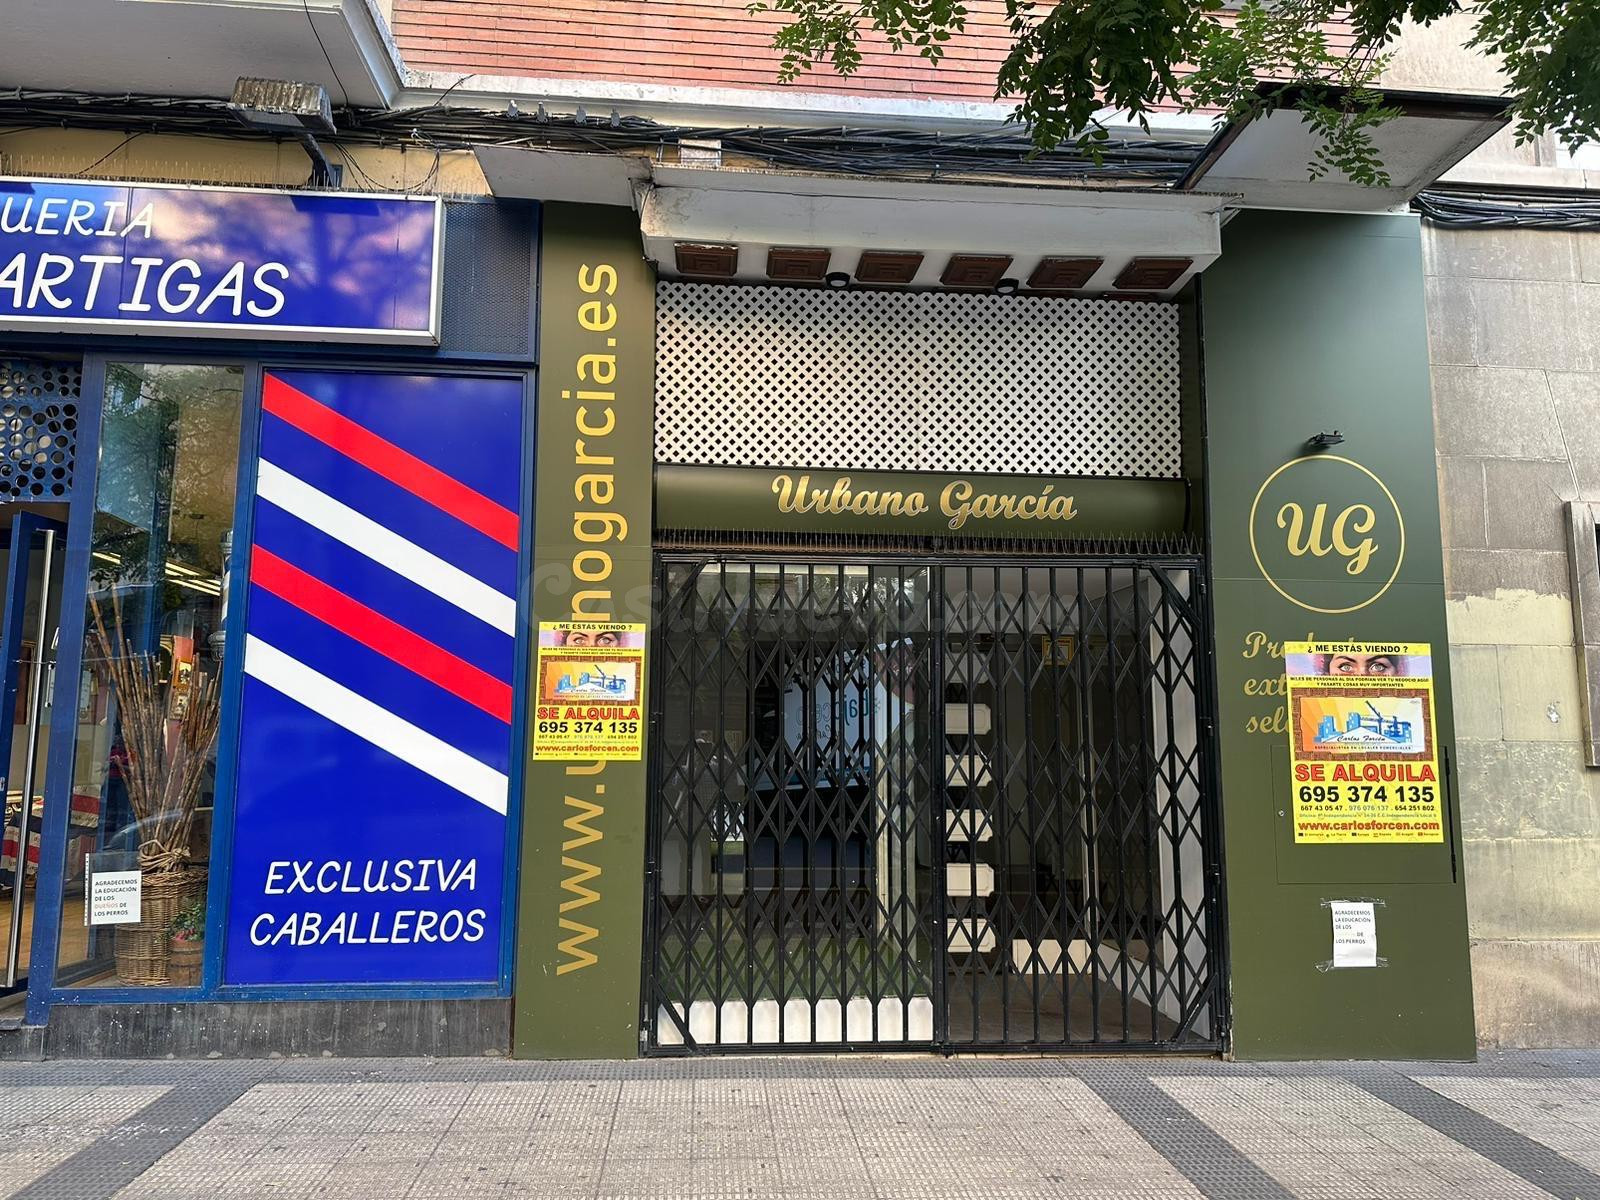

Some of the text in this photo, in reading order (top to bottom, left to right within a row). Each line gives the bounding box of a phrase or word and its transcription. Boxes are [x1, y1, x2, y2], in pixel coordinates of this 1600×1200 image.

[1, 196, 154, 239] UERIA
[0, 252, 289, 318] ARTIGAS
[771, 474, 1078, 530] Urbano García
[1276, 502, 1379, 575] UG
[556, 262, 629, 977] www.nogarcia.es
[1315, 644, 1330, 653] ME
[1332, 643, 1363, 653] ESTÁS
[1365, 645, 1401, 653] VIENDO
[537, 706, 640, 721] SE ALQUILA
[538, 721, 638, 734] 695 374 135
[1295, 763, 1437, 783] SE ALQUILA
[1299, 785, 1435, 803] 695 374 135
[1297, 820, 1440, 831] www.carlosforcen.com
[95, 879, 138, 887] AGRADECEMOS
[264, 858, 477, 895] EXCLUSIVA
[249, 908, 487, 947] CABALLEROS
